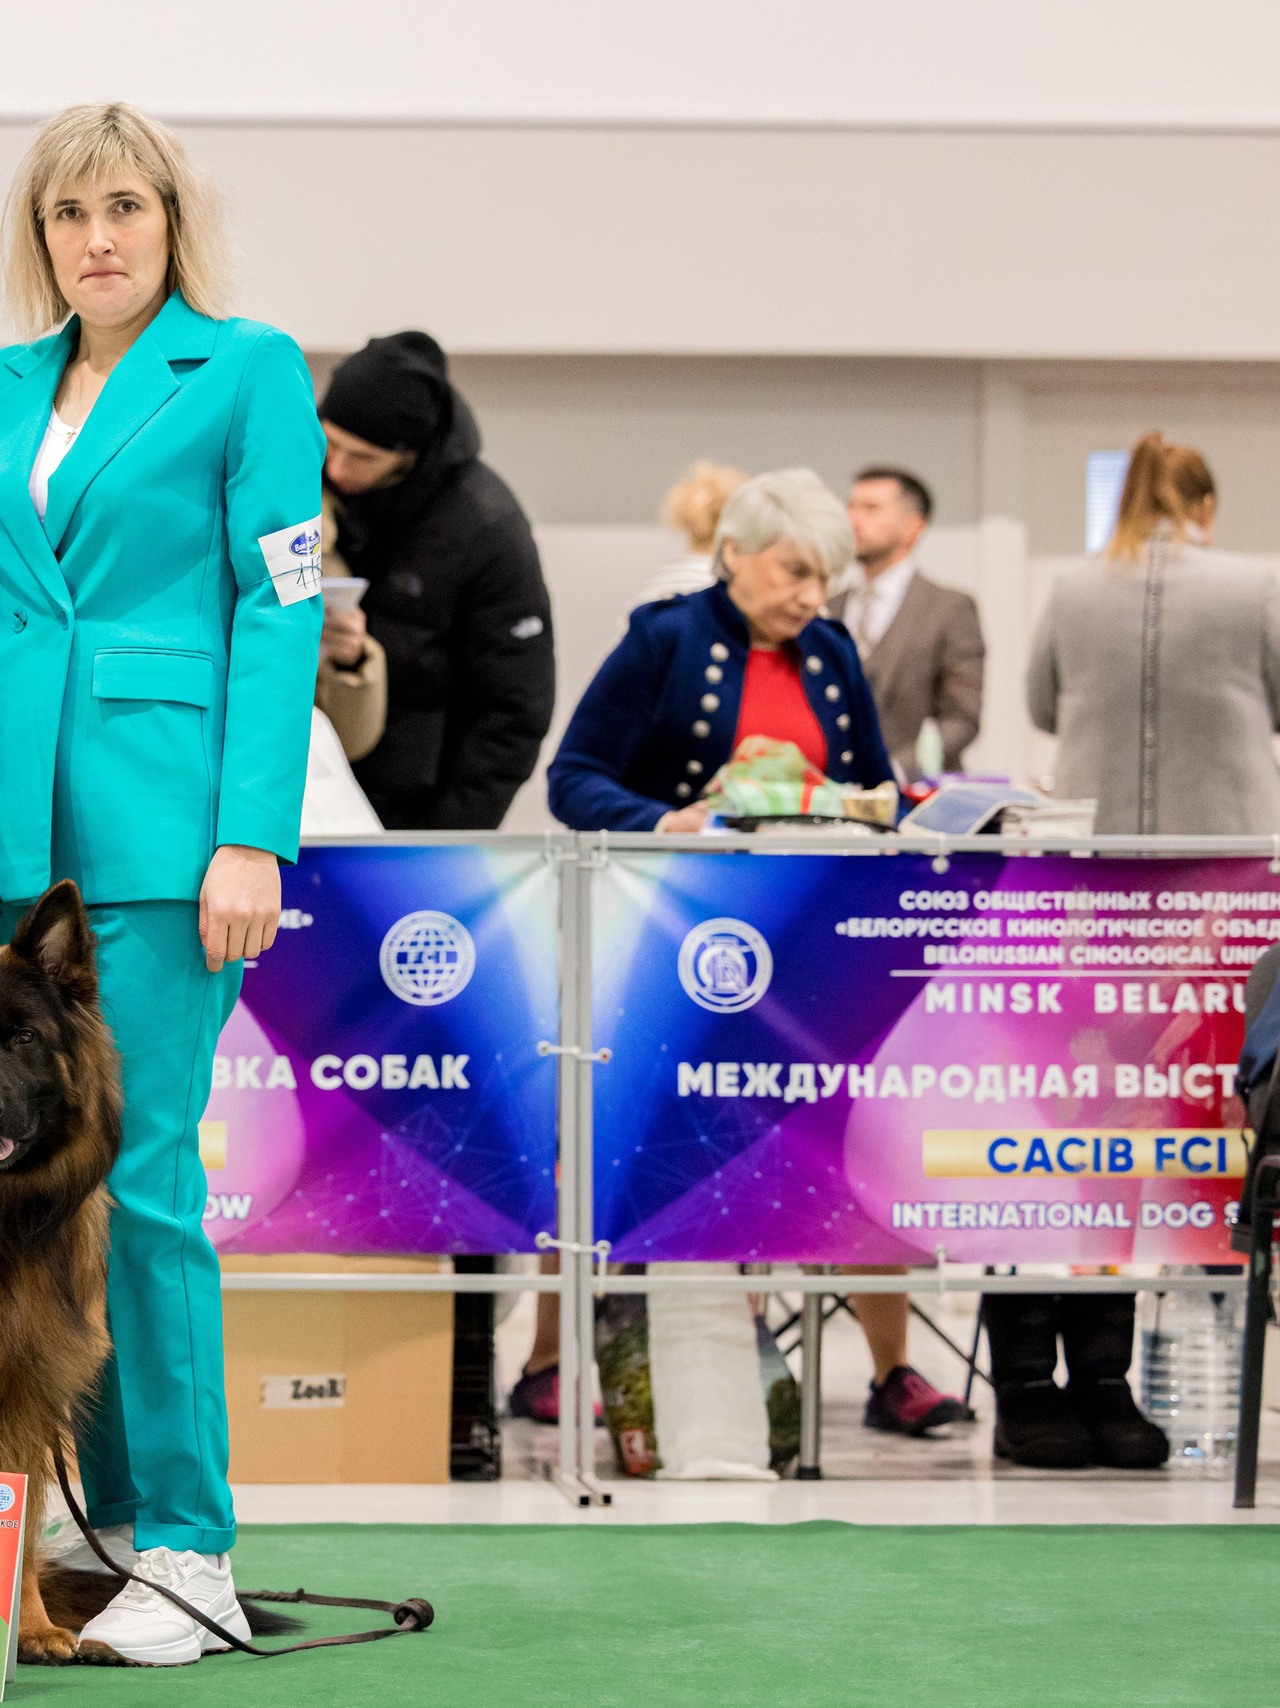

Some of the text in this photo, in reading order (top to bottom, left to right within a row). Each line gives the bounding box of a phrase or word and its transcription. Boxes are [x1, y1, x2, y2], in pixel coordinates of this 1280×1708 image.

[898, 890, 970, 911] СОЮЗ
[973, 890, 1151, 913] ОБЩЕСТВЕННЫХ
[1006, 918, 1205, 938] КИНОЛОГИЧЕСКОЕ
[923, 944, 1065, 965] BELORUSSIAN
[1070, 945, 1215, 965] CINOLOGICAL
[925, 982, 1062, 1014] MINSK
[310, 1053, 471, 1091] СОБАК
[677, 1061, 1098, 1103] МЕЖДУНАРОДНАЯ
[987, 1136, 1227, 1174] CACIB FCI
[892, 1202, 1132, 1229] INTERNATIONAL
[1141, 1202, 1216, 1229] DOG
